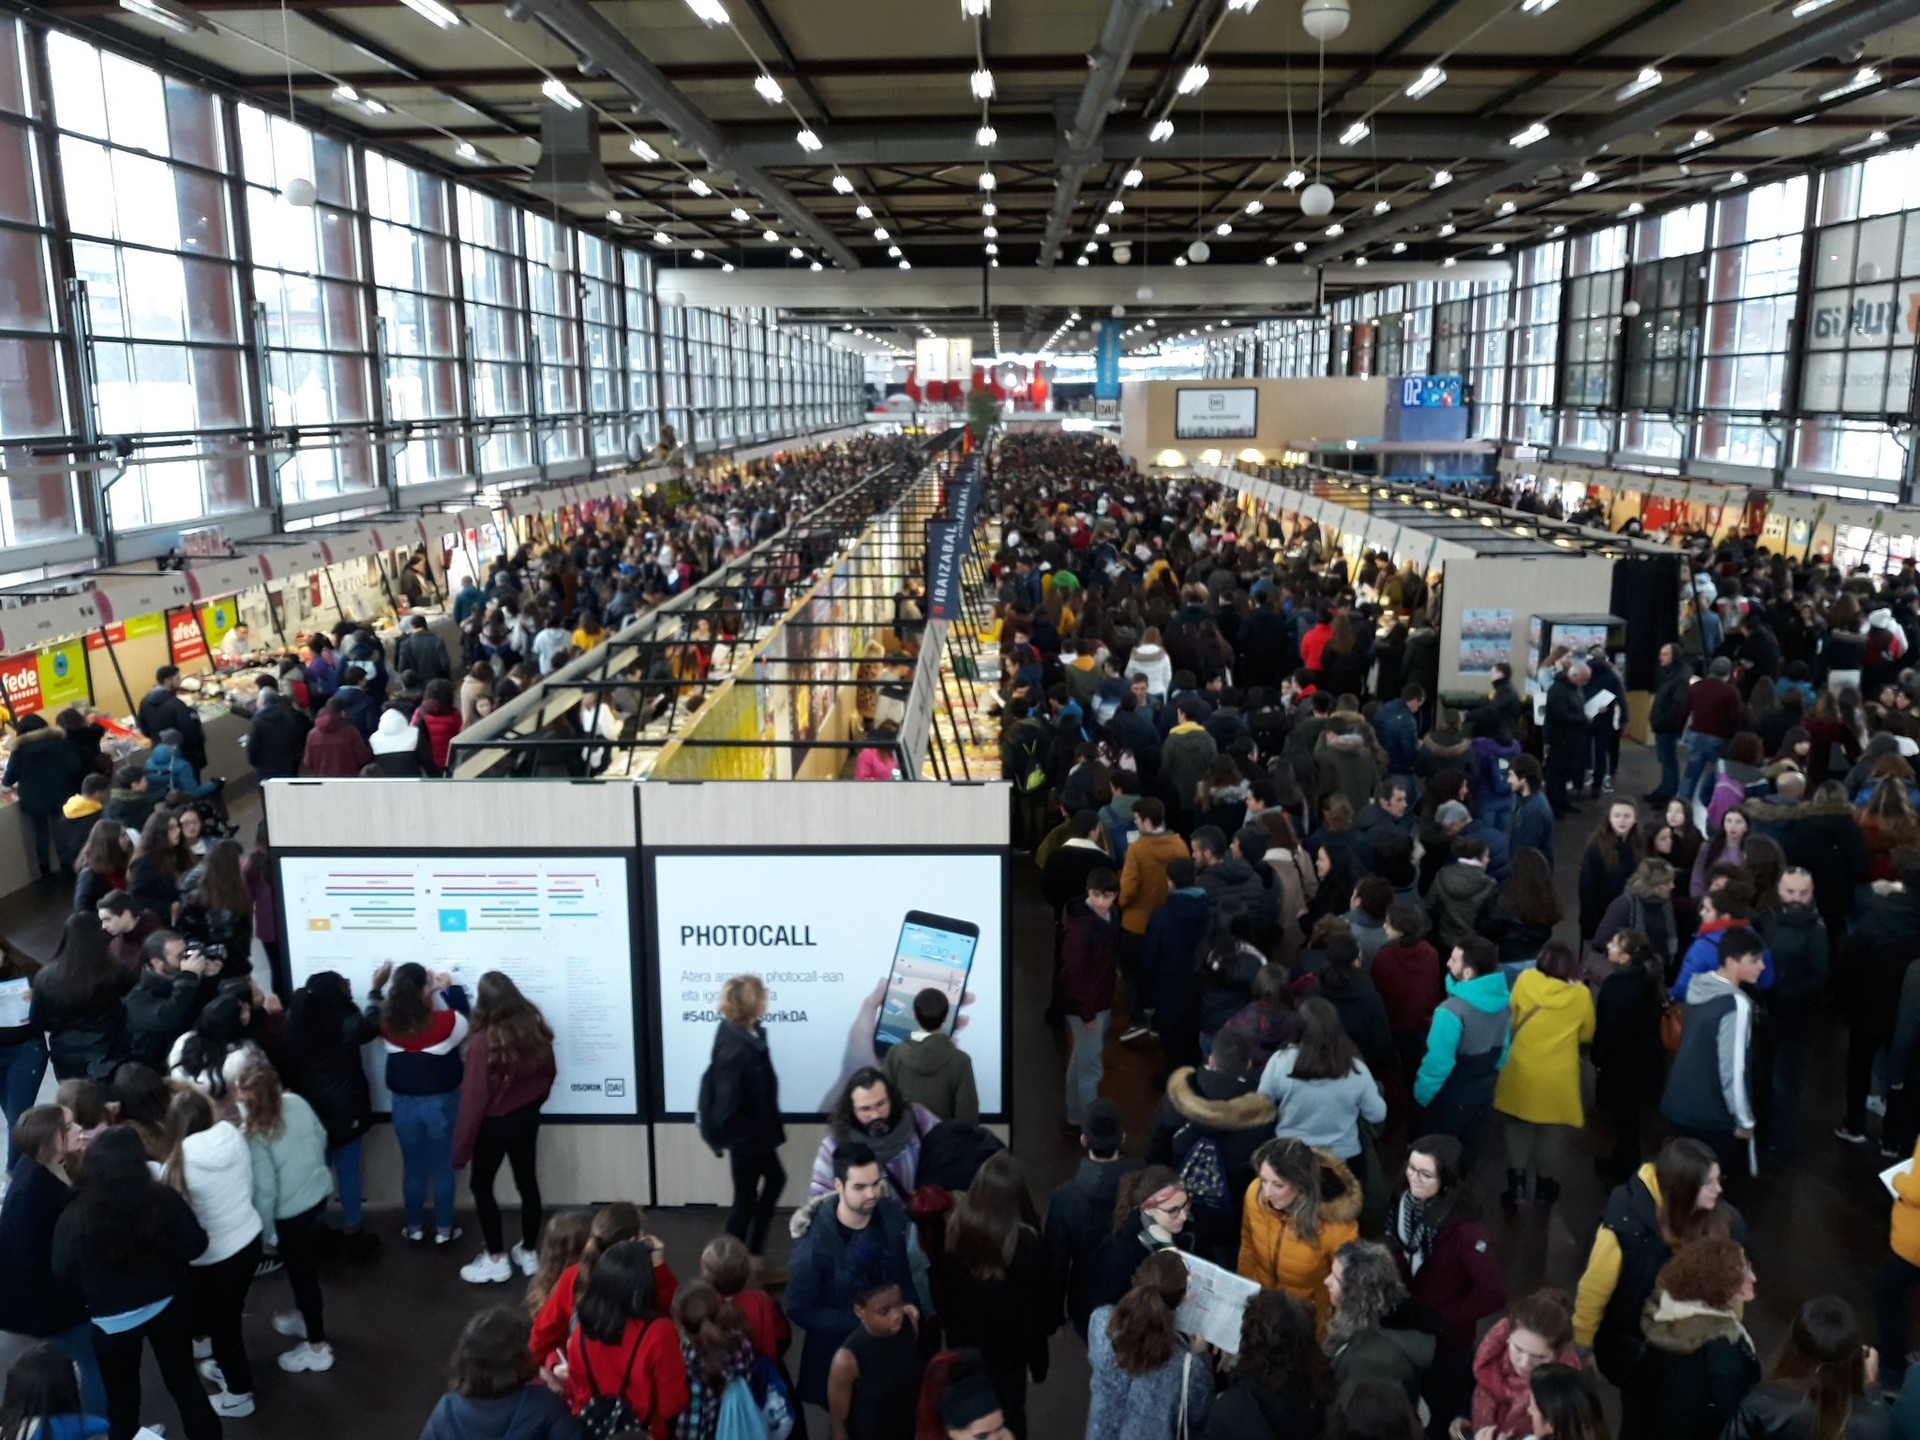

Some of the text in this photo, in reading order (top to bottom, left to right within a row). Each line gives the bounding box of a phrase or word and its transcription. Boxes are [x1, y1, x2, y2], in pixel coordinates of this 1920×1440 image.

[1403, 378, 1422, 406] 02
[934, 525, 957, 602] IBAIZABAL
[1, 668, 37, 693] fede
[681, 925, 817, 947] PHOTOCALL
[681, 970, 711, 982] Atera
[766, 970, 844, 985] photocall-ean
[681, 990, 699, 1001] eta
[683, 1010, 724, 1022] #54DA
